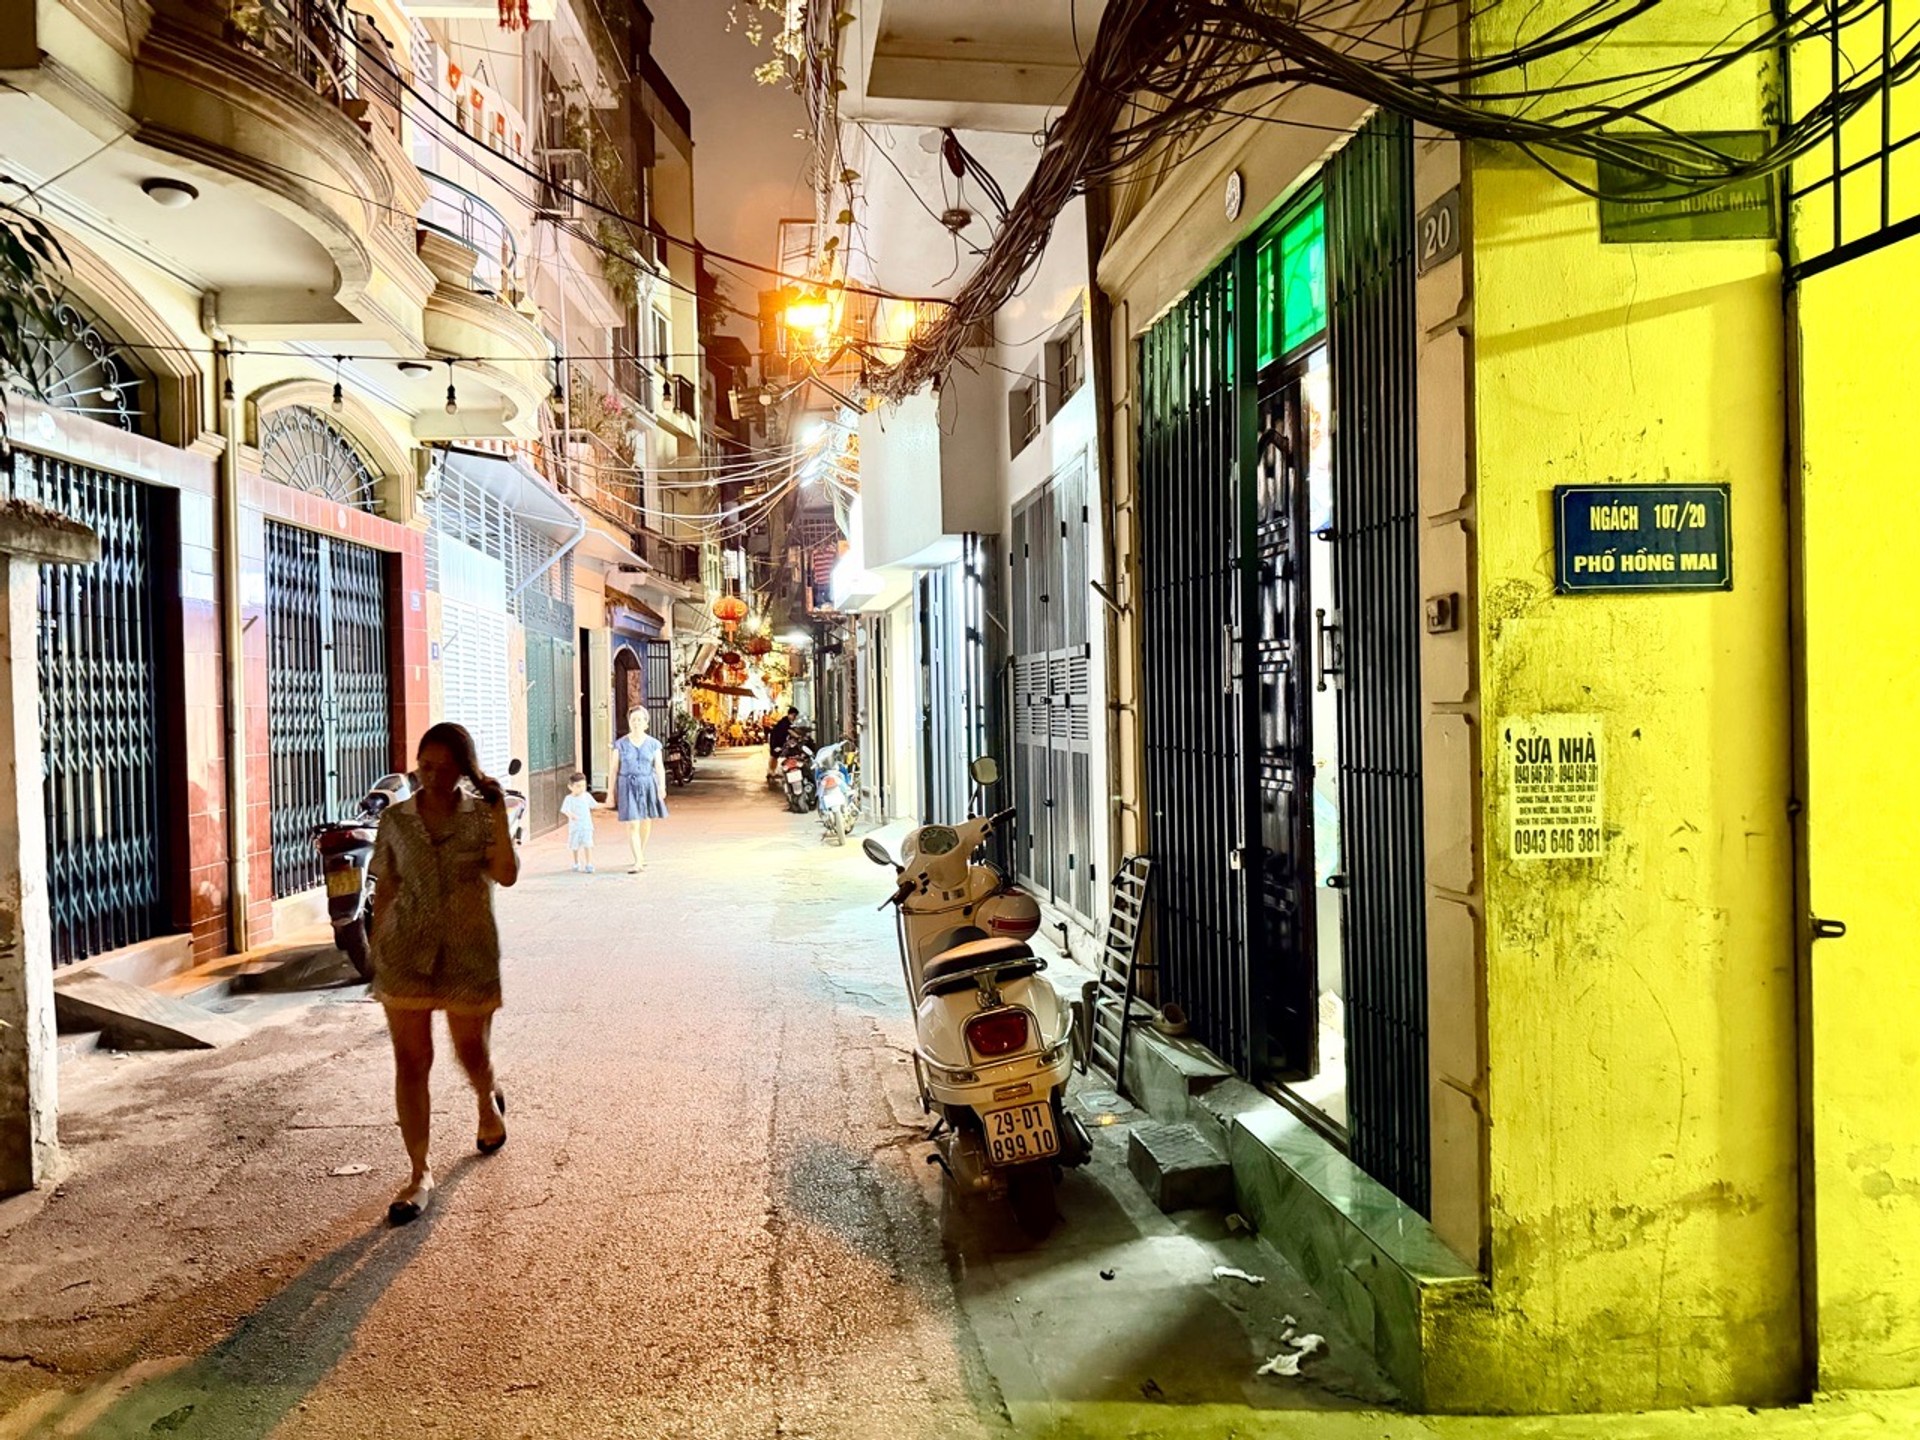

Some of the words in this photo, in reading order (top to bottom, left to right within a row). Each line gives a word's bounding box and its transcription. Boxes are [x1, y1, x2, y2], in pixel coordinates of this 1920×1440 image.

[1729, 190, 1761, 211] MAI
[1424, 207, 1451, 260] 20
[1589, 499, 1640, 531] NGÁCH
[1653, 501, 1706, 532] 107/20
[1573, 547, 1617, 573] PHỐ
[1620, 547, 1675, 572] HỒNG
[1680, 553, 1718, 572] MAI
[1515, 727, 1552, 764] SỬA
[1558, 731, 1597, 763] NHÀ
[1515, 829, 1546, 854] 0943
[1550, 829, 1574, 853] 646
[1578, 828, 1600, 852] 381
[994, 1105, 1043, 1136] 29-D1
[993, 1129, 1054, 1161] 899.10
